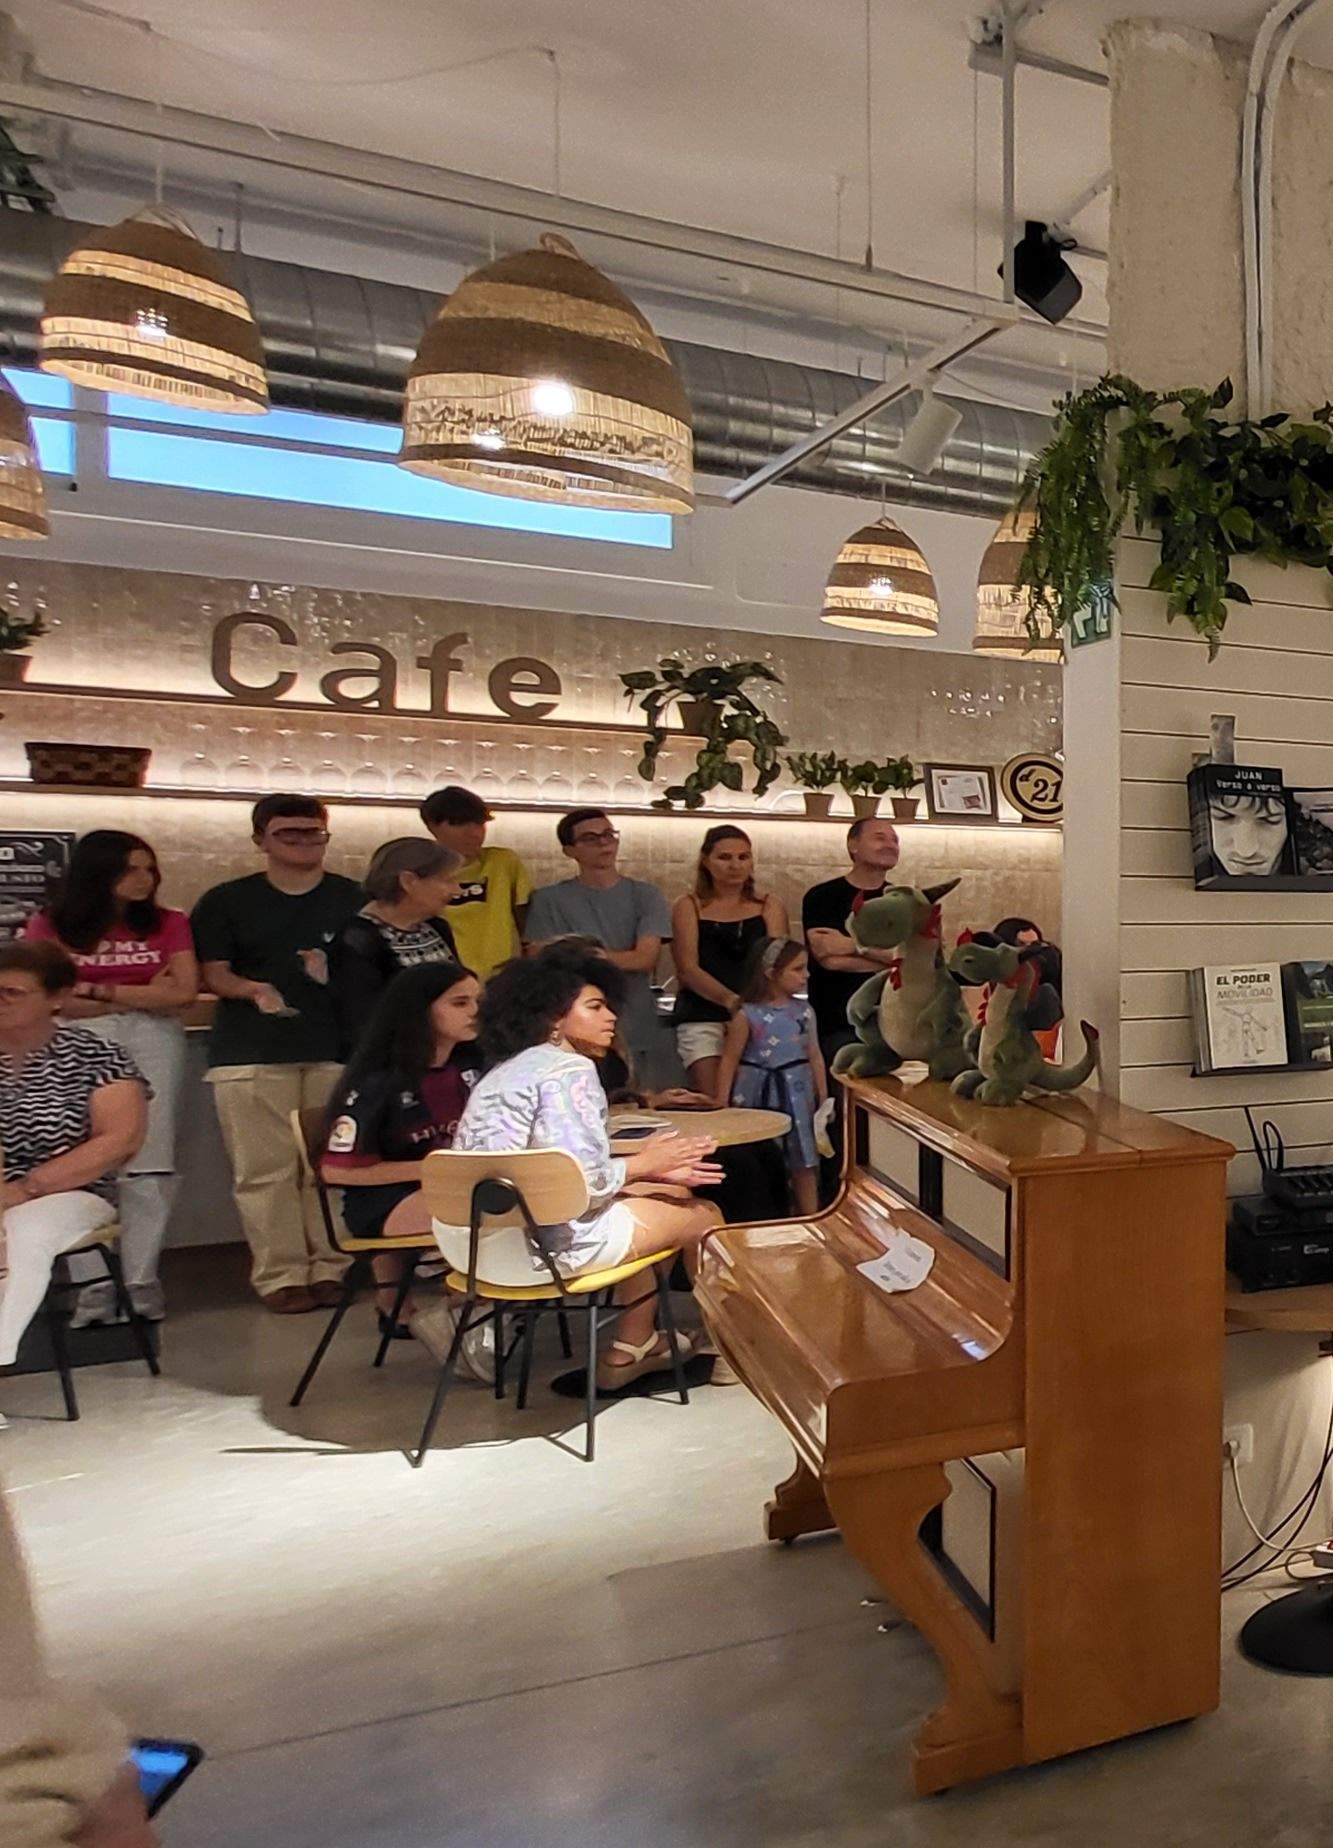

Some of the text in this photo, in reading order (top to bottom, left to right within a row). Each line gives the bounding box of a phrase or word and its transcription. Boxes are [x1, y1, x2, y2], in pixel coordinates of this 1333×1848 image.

[210, 611, 563, 718] Cafe
[1234, 770, 1263, 781] JUAN
[1216, 973, 1271, 986] EL PODER
